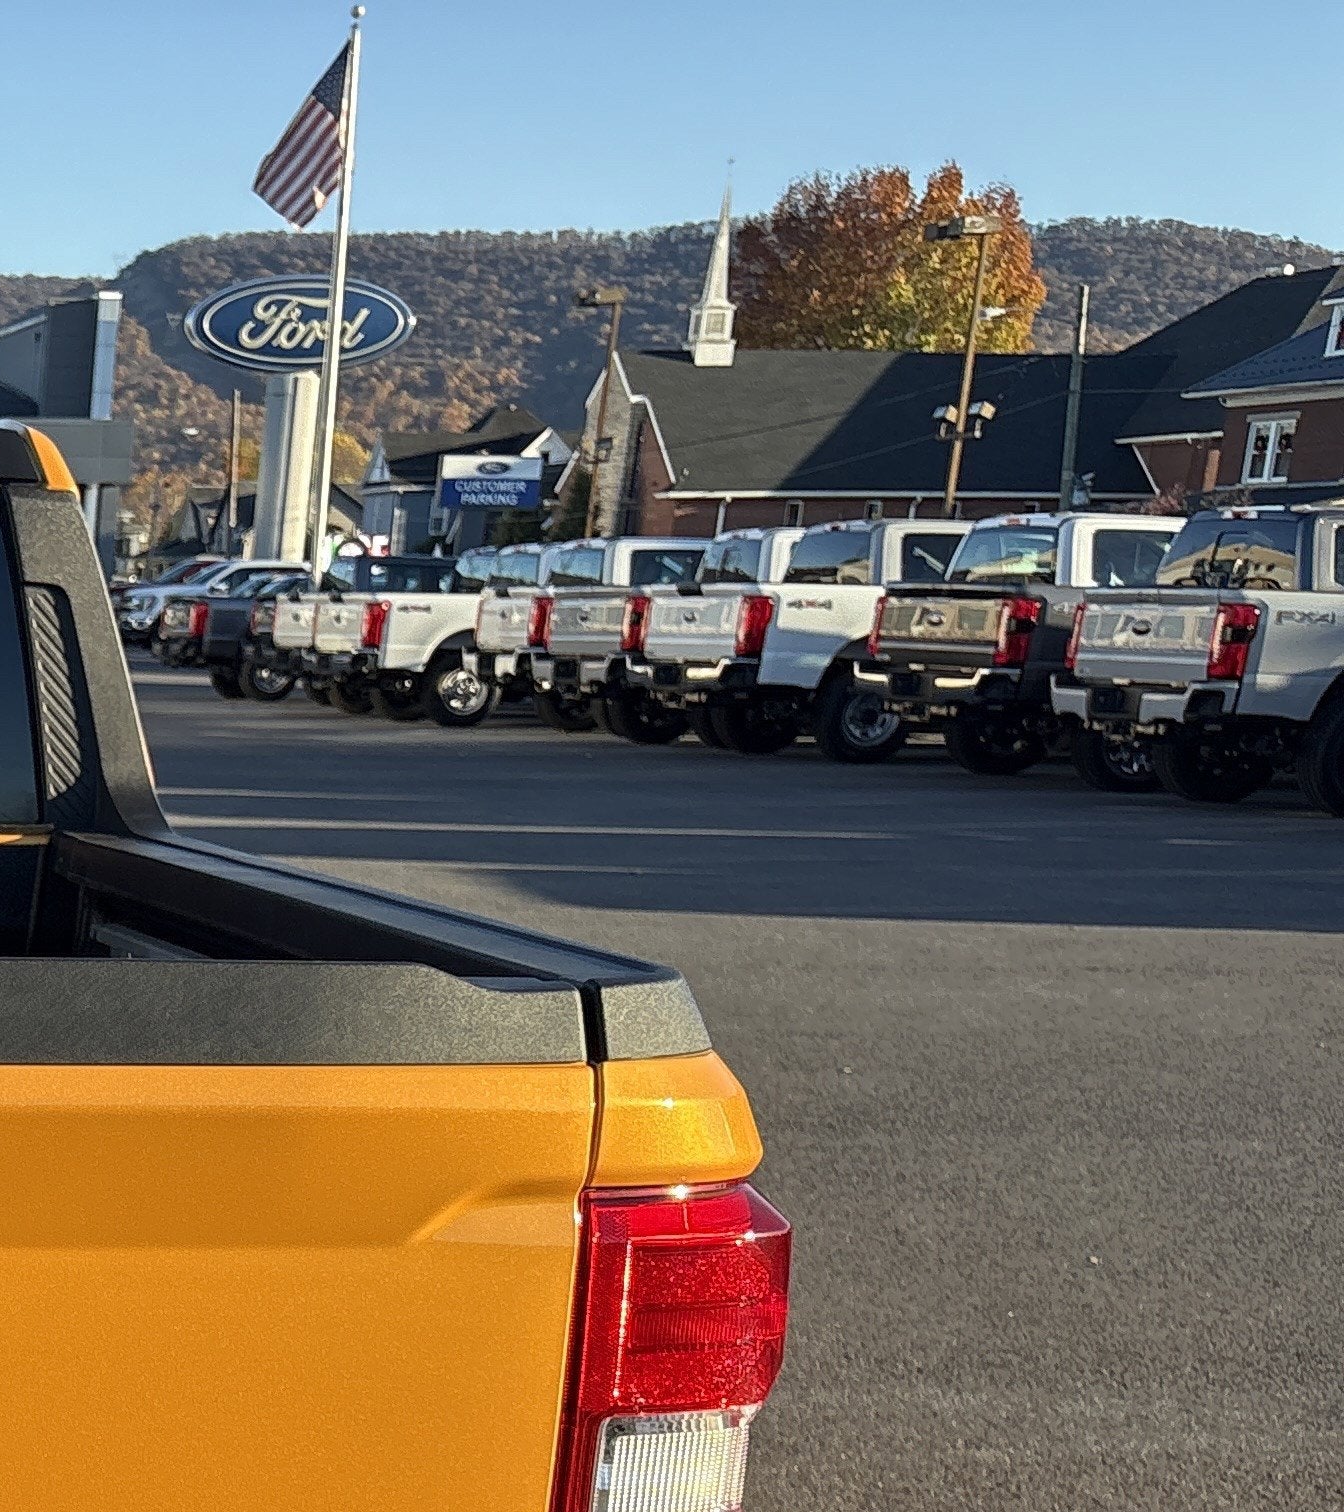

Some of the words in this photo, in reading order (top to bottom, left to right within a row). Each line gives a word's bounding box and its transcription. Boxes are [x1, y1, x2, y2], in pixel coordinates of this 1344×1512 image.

[238, 293, 372, 350] Ford
[454, 480, 527, 493] CUSTOMER
[460, 493, 519, 506] PARKING
